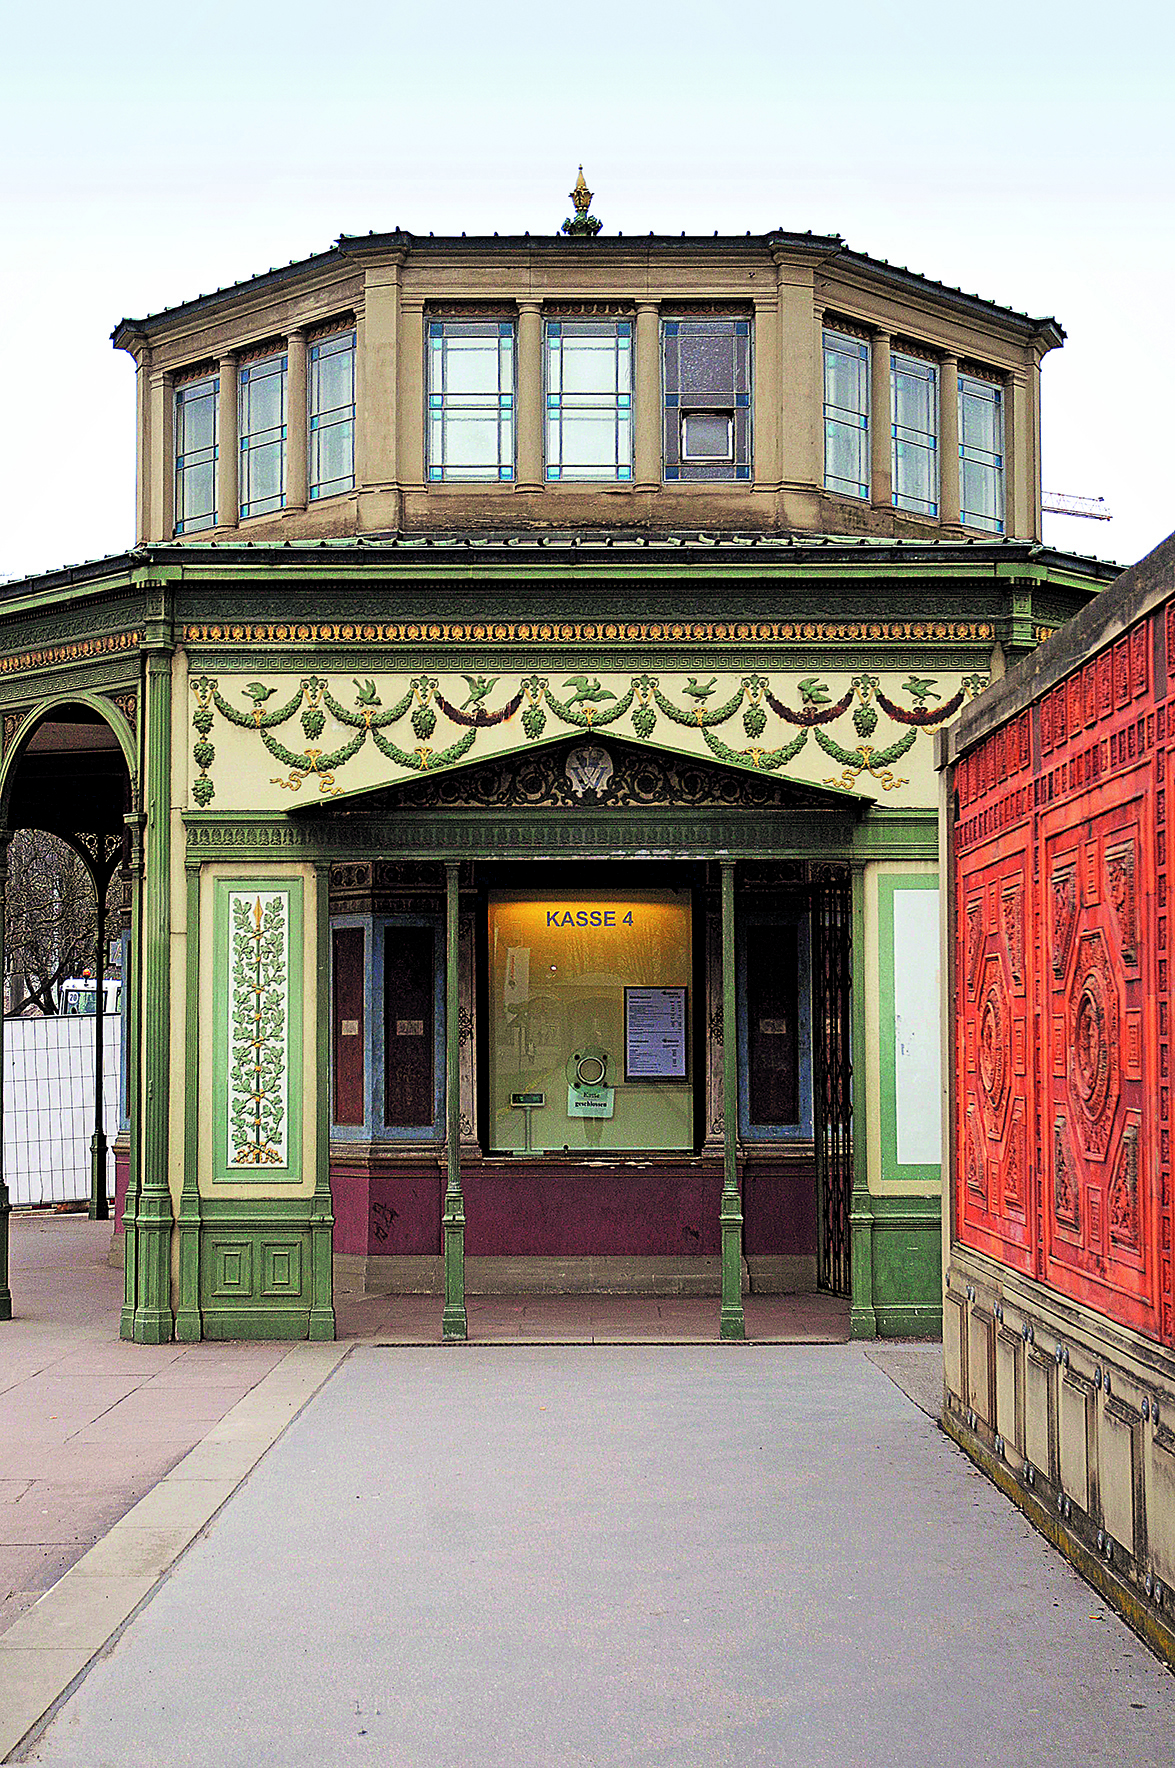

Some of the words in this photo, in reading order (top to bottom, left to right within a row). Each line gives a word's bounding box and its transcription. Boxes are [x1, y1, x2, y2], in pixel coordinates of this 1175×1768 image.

[546, 910, 616, 927] KASSE
[622, 910, 633, 926] 4
[70, 993, 77, 1002] 20
